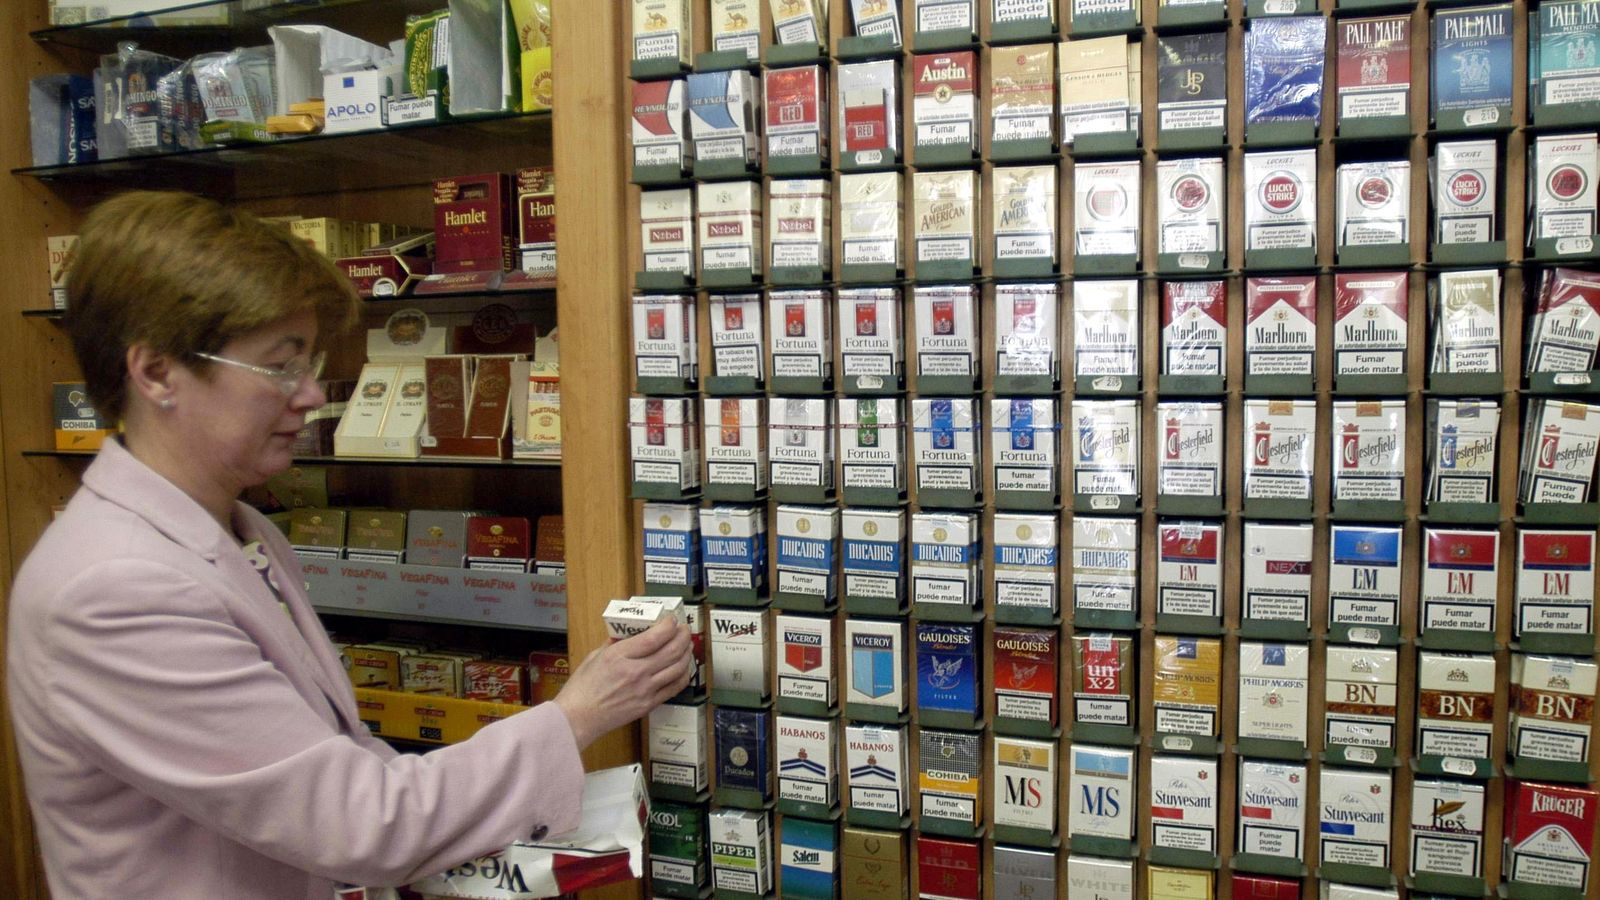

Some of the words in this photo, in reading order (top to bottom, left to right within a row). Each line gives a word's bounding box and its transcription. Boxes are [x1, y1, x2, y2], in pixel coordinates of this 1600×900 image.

[999, 4, 1044, 16] puede
[1550, 5, 1578, 27] PALL
[1445, 18, 1469, 39] PALL
[1475, 15, 1505, 37] MALL
[1347, 24, 1371, 44] PALL
[1375, 22, 1404, 42] MALL
[921, 64, 966, 82] Austin
[327, 103, 376, 117] APOLO
[389, 103, 409, 112] Fumar
[411, 100, 433, 110] puede
[635, 103, 679, 113] REYNOLDS
[402, 111, 421, 120] matar
[782, 107, 801, 120] RED
[858, 126, 871, 137] RED
[931, 125, 956, 133] Fumar
[1268, 183, 1294, 192] LUCKY
[1456, 180, 1477, 188] LUCKY
[1267, 191, 1295, 201] STRIKE
[1454, 187, 1479, 195] STRIKE
[930, 203, 953, 212] GOLDEN
[445, 209, 487, 226] Hamlet
[921, 206, 965, 231] AMERICAN
[1455, 229, 1477, 237] puede
[349, 263, 382, 276] Hamlet
[1172, 322, 1217, 339] Marlboro
[1255, 323, 1307, 343] Marlboro
[1344, 320, 1398, 341] Marlboro
[1449, 319, 1494, 337] Marlboro
[1551, 319, 1595, 340] Marlboro
[715, 331, 755, 341] Fortuna
[638, 341, 676, 350] Fortuna
[775, 339, 817, 349] Fortuna
[845, 338, 889, 347] Fortuna
[922, 337, 967, 347] Fortuna
[1356, 355, 1384, 363] Fumar
[1342, 366, 1370, 374] puede
[1372, 365, 1399, 373] matar
[63, 420, 95, 429] COHIBA
[1167, 427, 1213, 460] Chesterfield
[637, 446, 675, 457] Fortuna
[712, 447, 751, 457] Fortuna
[775, 446, 817, 458] Fortuna
[847, 448, 890, 459] Fortuna
[922, 451, 967, 460] Fortuna
[1000, 451, 1047, 461] Fortuna
[1344, 435, 1396, 467] Chesterfield
[1442, 437, 1493, 467] Chesterfield
[1540, 436, 1595, 470] Chesterfield
[999, 482, 1024, 490] puede
[1543, 481, 1577, 492] Fumar
[1542, 490, 1576, 500] puede
[475, 535, 518, 544] VEGAFINA
[646, 533, 685, 550] DUCADOS
[707, 540, 747, 556] DUCADOS
[782, 540, 825, 559] DUCADOS
[849, 543, 893, 562] DUCADOS
[919, 544, 962, 562] DUCADOS
[1002, 547, 1048, 565] DUCADOS
[1081, 550, 1128, 568] DUCADOS
[1269, 563, 1304, 573] NEXT
[341, 568, 387, 580] VEGAFINA
[401, 573, 449, 586] VEGAFINA
[463, 577, 515, 590] VEGAFINA
[781, 584, 802, 593] puede
[917, 593, 939, 602] puede
[1078, 601, 1105, 609] puede
[1351, 604, 1377, 612] Fumar
[1338, 614, 1363, 623] puede
[1365, 615, 1389, 623] matar
[1445, 609, 1472, 618] Fumar
[1541, 610, 1569, 619] Fumar
[714, 619, 758, 635] West
[1431, 619, 1458, 628] puede
[1460, 620, 1486, 628] matar
[1527, 620, 1555, 630] puede
[1558, 621, 1582, 630] matar
[786, 633, 820, 643] VICEROY
[855, 636, 891, 646] VICEROY
[919, 632, 970, 644] GAULOISES
[997, 639, 1050, 652] GAULOISES
[1088, 663, 1114, 677] un
[1185, 674, 1215, 683] MORRIS
[1243, 678, 1270, 687] PHILIP
[1271, 679, 1304, 689] MORRIS
[783, 689, 805, 697] puede
[1345, 684, 1378, 703] BN
[1439, 695, 1475, 717] BN
[1536, 694, 1576, 719] BN
[1078, 713, 1102, 721] puede
[781, 728, 826, 740] HABANOS
[1331, 736, 1359, 745] puede
[1362, 736, 1388, 746] matar
[850, 742, 894, 752] HABANOS
[725, 766, 755, 777] Ducados
[928, 771, 968, 781] COHIBA
[793, 784, 813, 792] fumar
[1004, 775, 1041, 808] MS
[782, 792, 803, 800] puede
[804, 794, 824, 802] matar
[1081, 784, 1119, 818] MS
[1155, 790, 1212, 808] Stuyvesant
[1245, 791, 1298, 808] Stuyvesant
[853, 801, 875, 809] puede
[936, 799, 958, 807] fumar
[1531, 791, 1585, 819] KRUGER
[650, 810, 682, 828] KOOL
[924, 808, 949, 816] puede
[950, 810, 972, 819] matar
[1324, 805, 1384, 824] Stuyvesant
[1260, 832, 1282, 840] Fumar
[1259, 839, 1282, 847] puede
[714, 844, 755, 858] PIPER
[793, 850, 820, 863] Salem
[444, 857, 532, 893] West
[654, 871, 674, 880] puede
[675, 873, 691, 881] matar
[1071, 878, 1130, 892] WHITE
